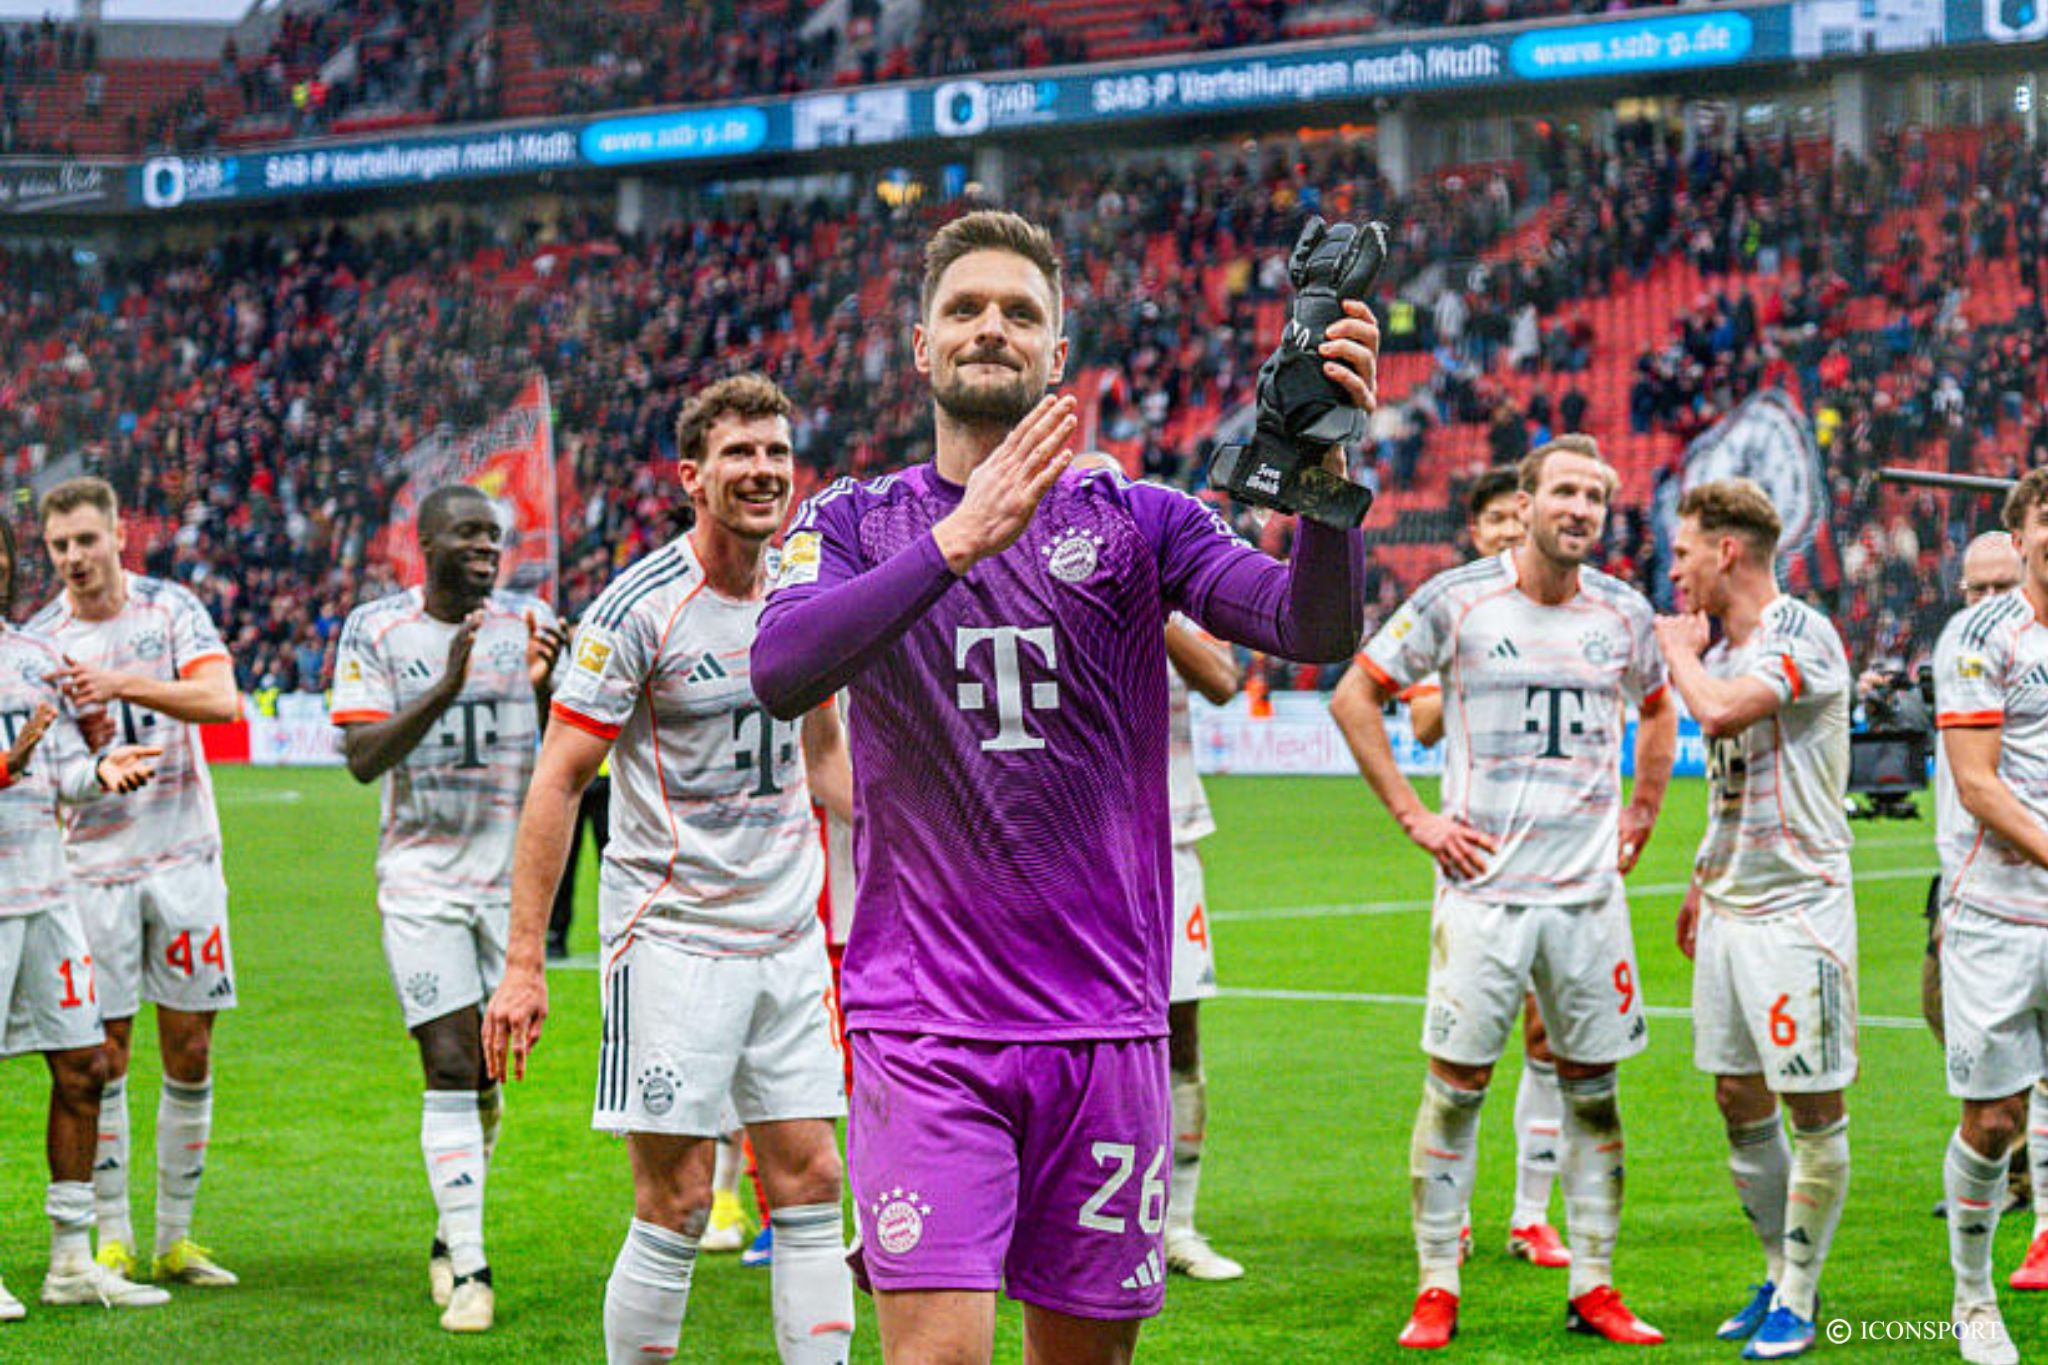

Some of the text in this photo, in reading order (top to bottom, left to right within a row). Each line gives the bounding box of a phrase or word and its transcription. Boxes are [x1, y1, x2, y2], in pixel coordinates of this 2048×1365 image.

[1353, 48, 1424, 87] nach
[956, 626, 1060, 751] T
[440, 699, 498, 769] T
[1525, 685, 1585, 759] T
[164, 923, 226, 977] 44
[1185, 902, 1208, 952] 4
[1612, 959, 1635, 1015] 9
[1768, 993, 1797, 1048] 6
[1077, 1140, 1167, 1235] 26
